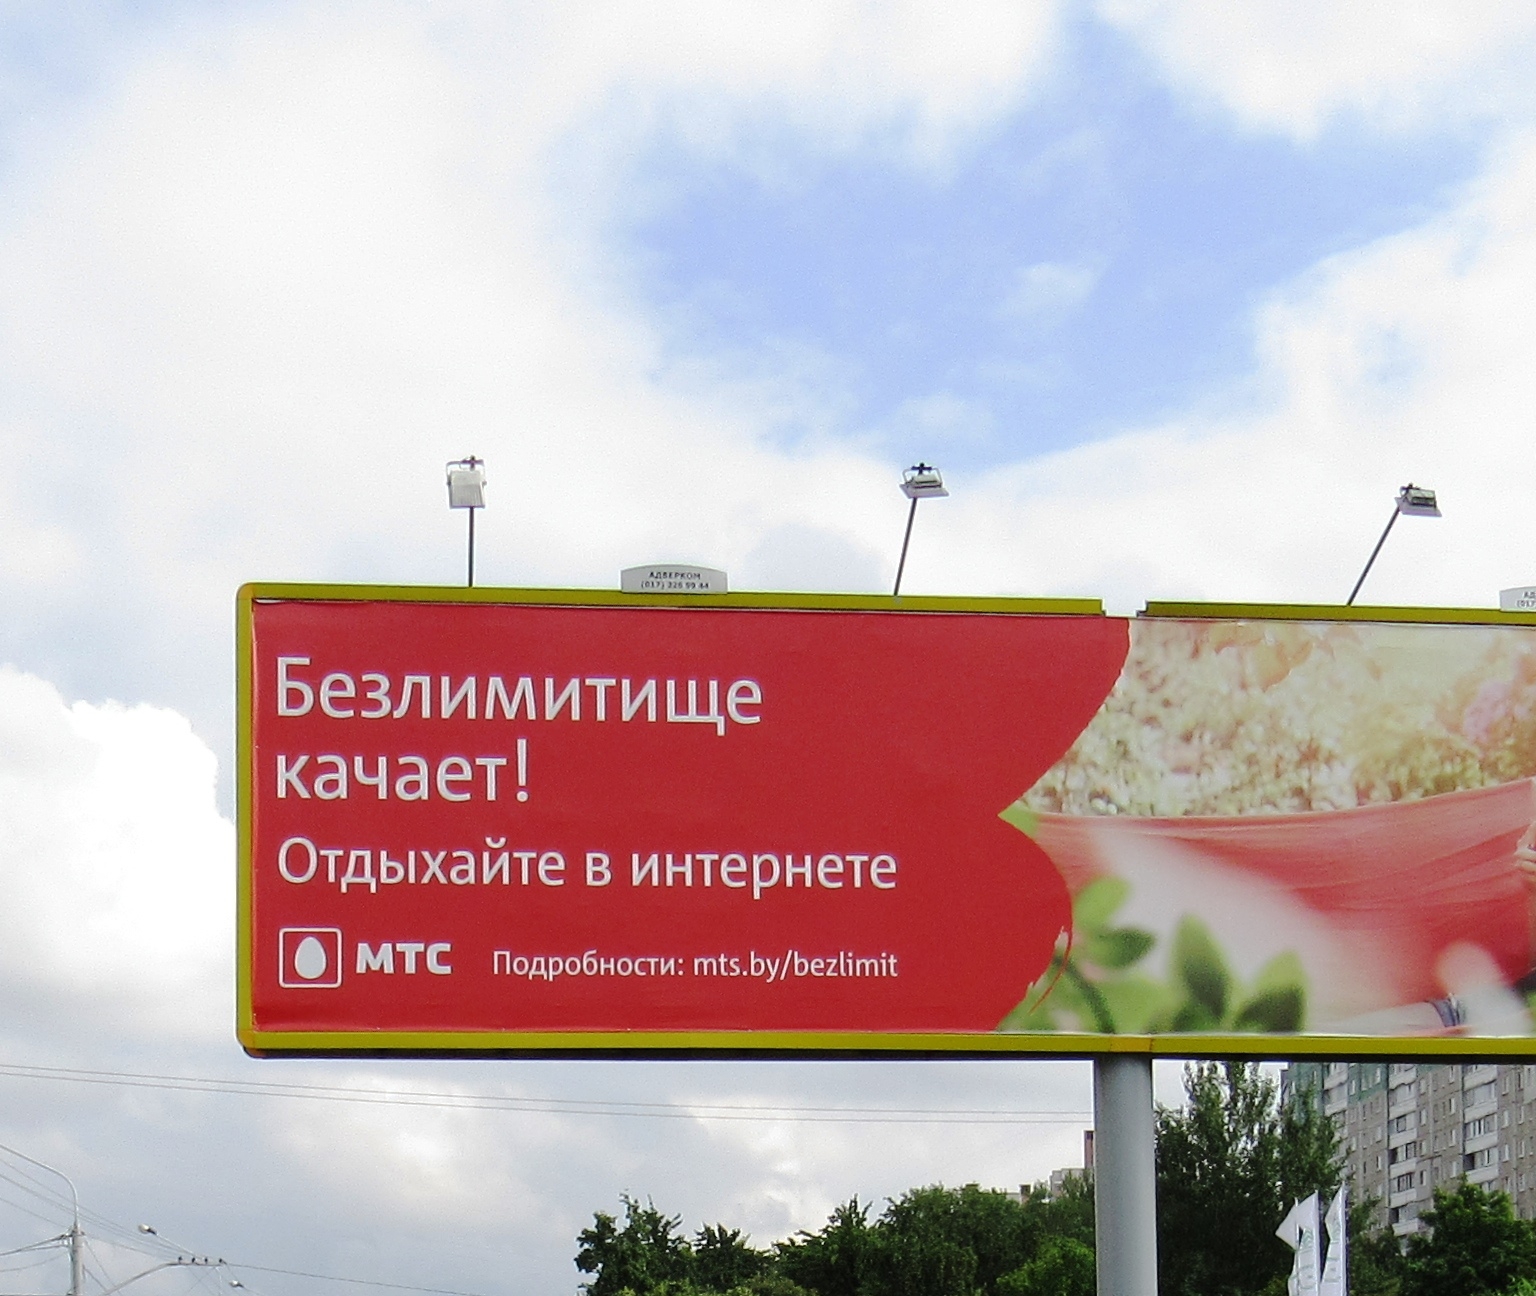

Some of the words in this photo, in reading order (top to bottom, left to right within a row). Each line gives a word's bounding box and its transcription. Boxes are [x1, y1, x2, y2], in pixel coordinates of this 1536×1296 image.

[648, 571, 701, 580] АДВЕРКОМ
[276, 655, 763, 736] Безлимитище
[275, 738, 530, 802] качает!
[276, 836, 565, 893] Отдыхайте
[584, 851, 612, 887] в
[631, 850, 898, 900] интернете
[355, 941, 453, 975] МТС
[492, 949, 685, 981] Подробности:
[692, 949, 899, 984] mts.by/bezlimit
